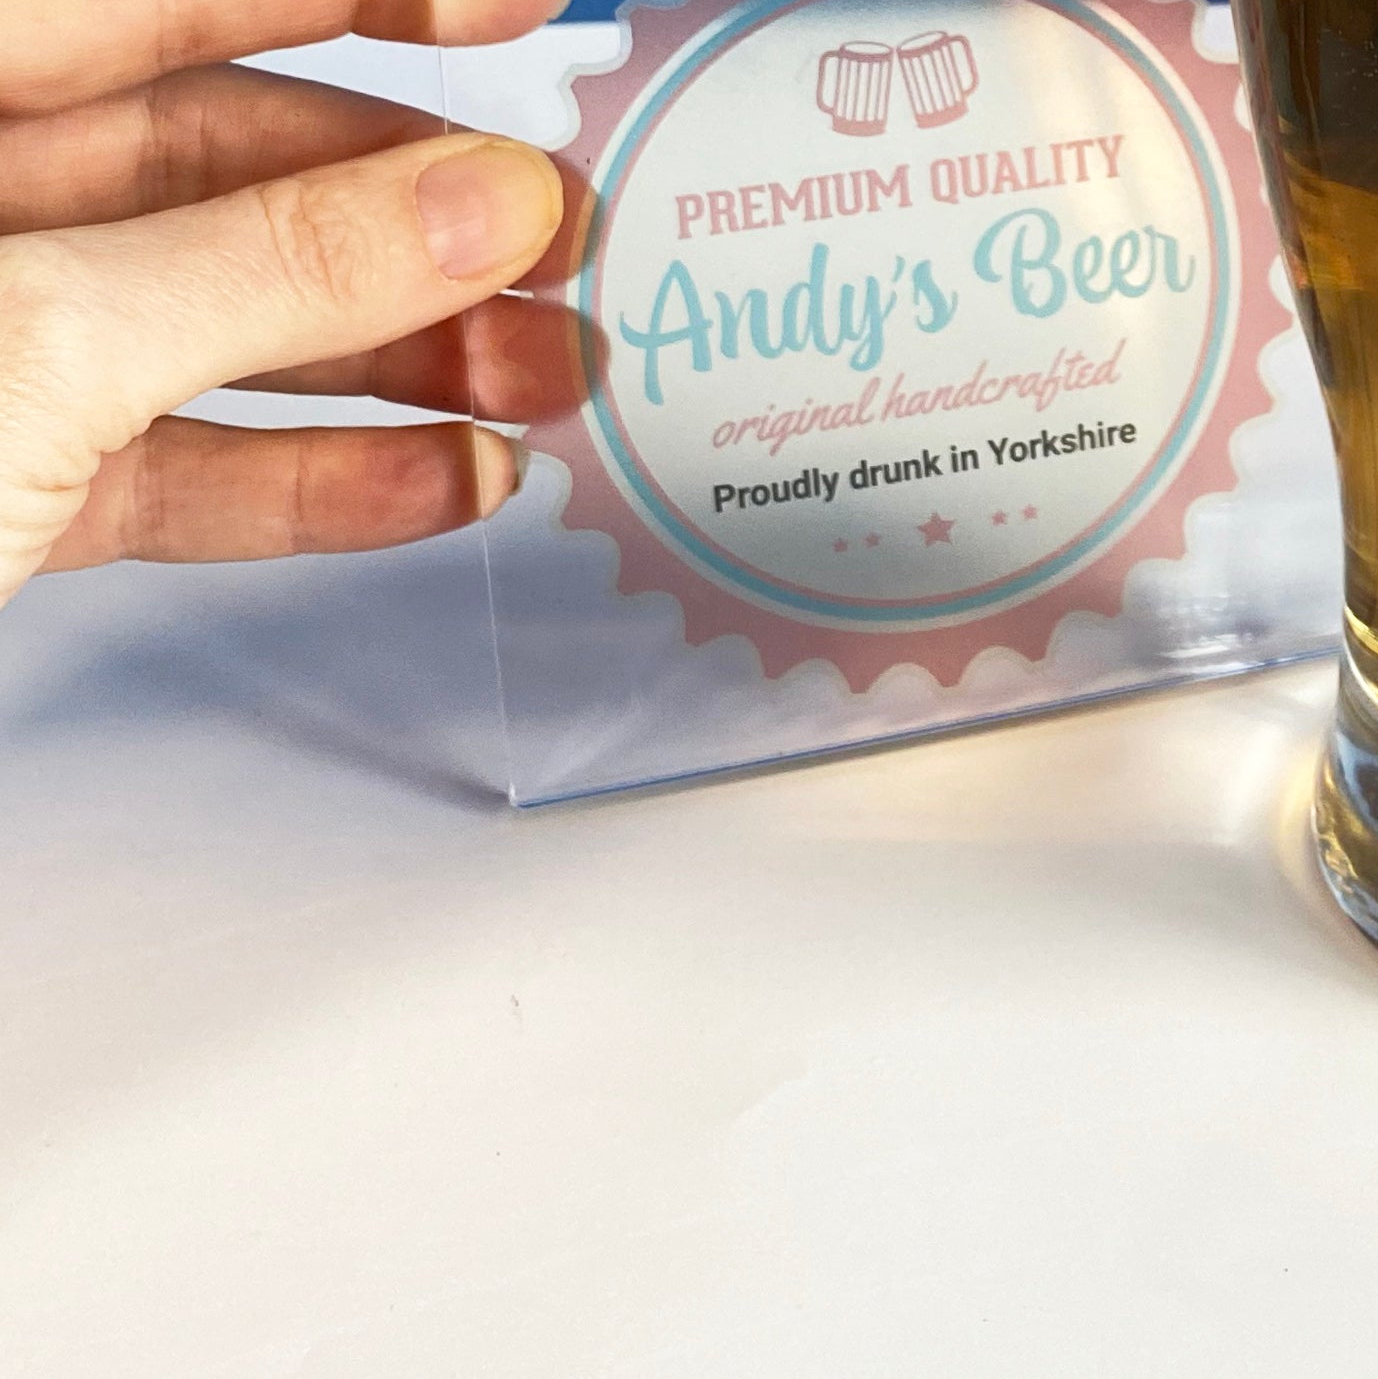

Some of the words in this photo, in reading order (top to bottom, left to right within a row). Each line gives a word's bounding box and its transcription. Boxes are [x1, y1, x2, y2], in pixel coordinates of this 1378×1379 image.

[675, 163, 912, 240] PREMIUM
[930, 134, 1126, 204] QUALITY
[619, 241, 958, 406] Andy's
[973, 207, 1197, 319] Beer
[711, 376, 882, 458] original
[883, 337, 1128, 422] handcrafted
[712, 465, 840, 514] Proudly
[849, 448, 943, 491] drunk
[950, 444, 980, 474] in
[985, 419, 1138, 468] Yorkshire
